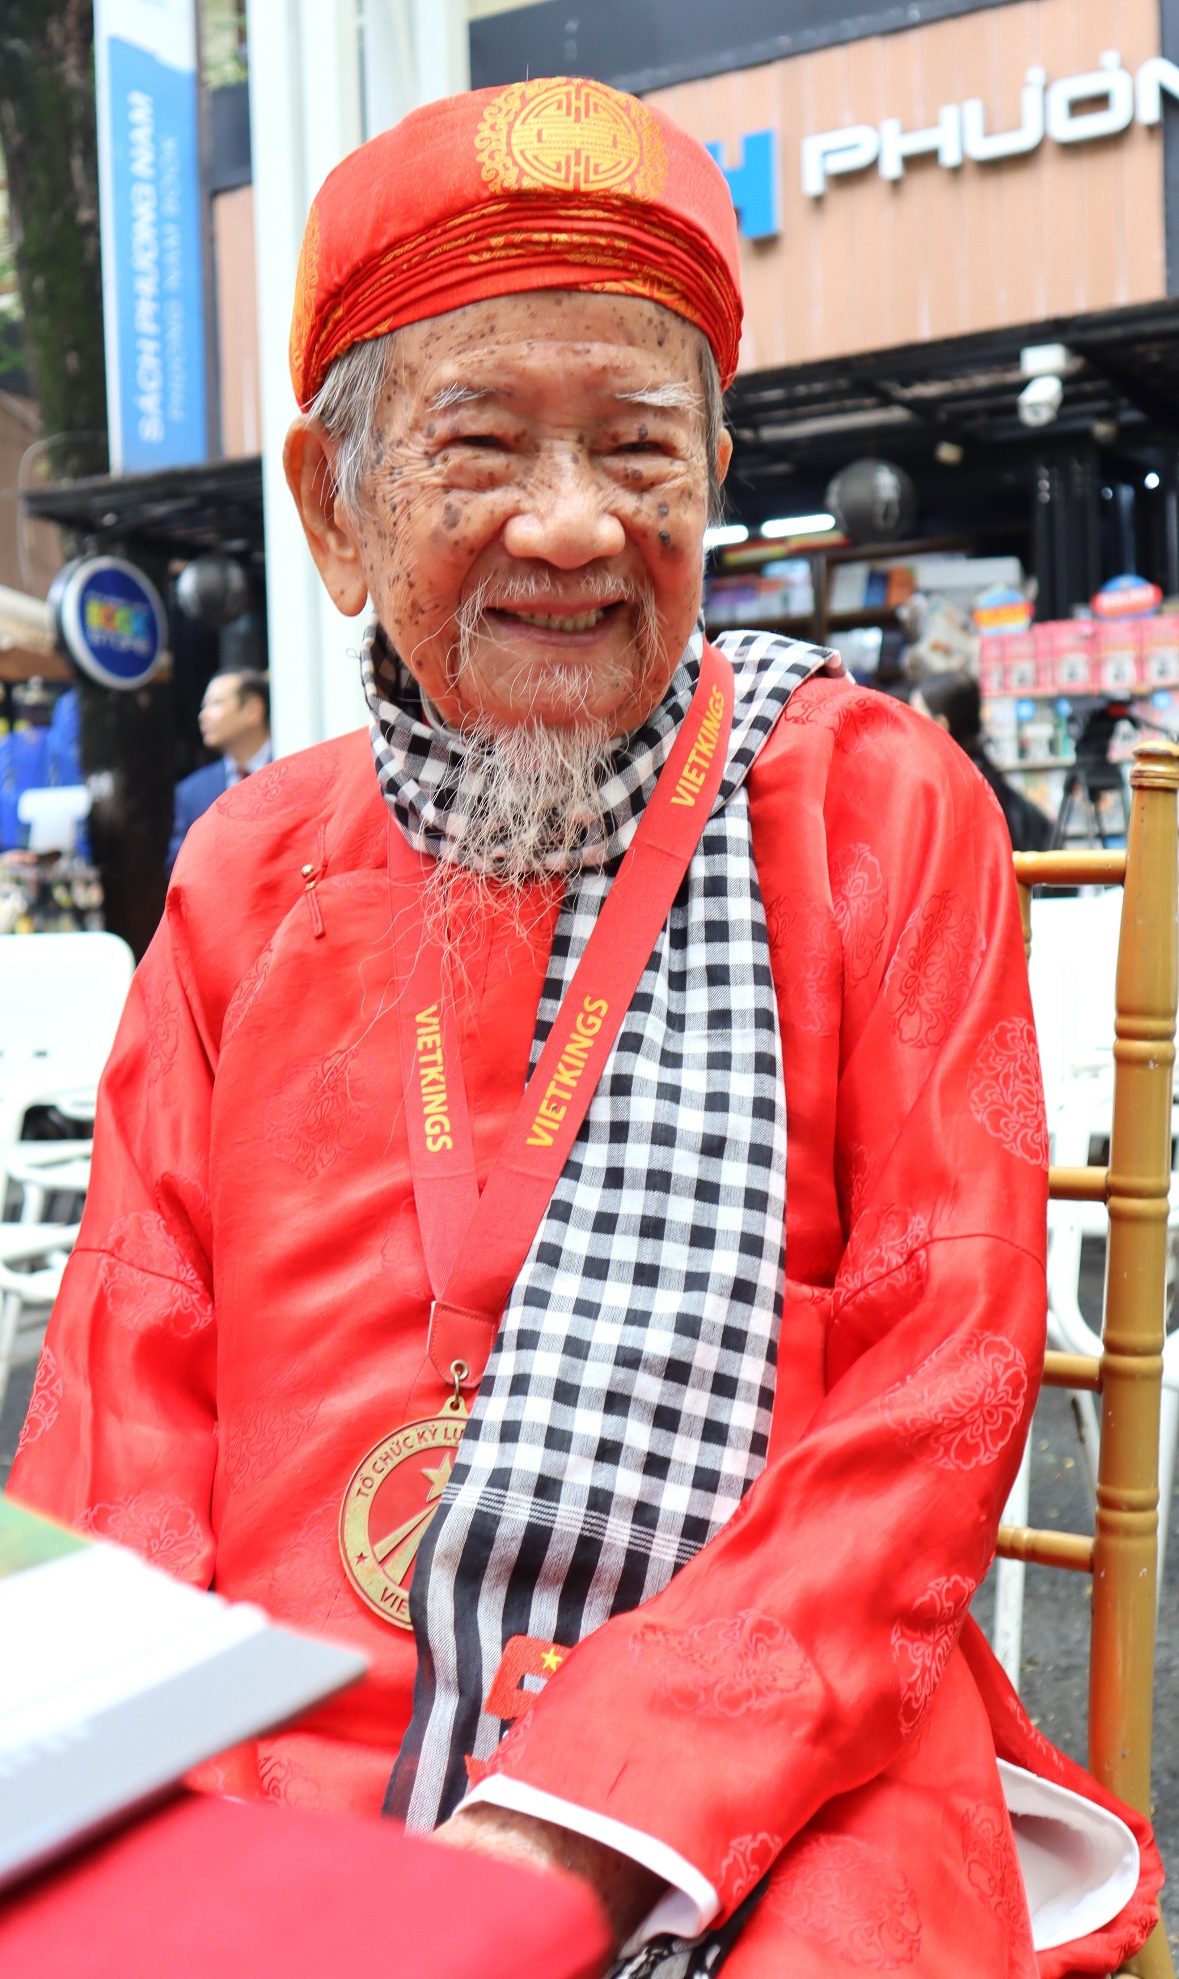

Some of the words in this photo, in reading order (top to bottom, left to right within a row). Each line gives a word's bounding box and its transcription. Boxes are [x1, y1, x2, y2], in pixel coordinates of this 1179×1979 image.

[127, 90, 158, 179] NAM
[670, 683, 725, 807] VIETKINGS
[414, 1003, 453, 1153] VIETKINGS
[525, 995, 608, 1147] VIETKINGS
